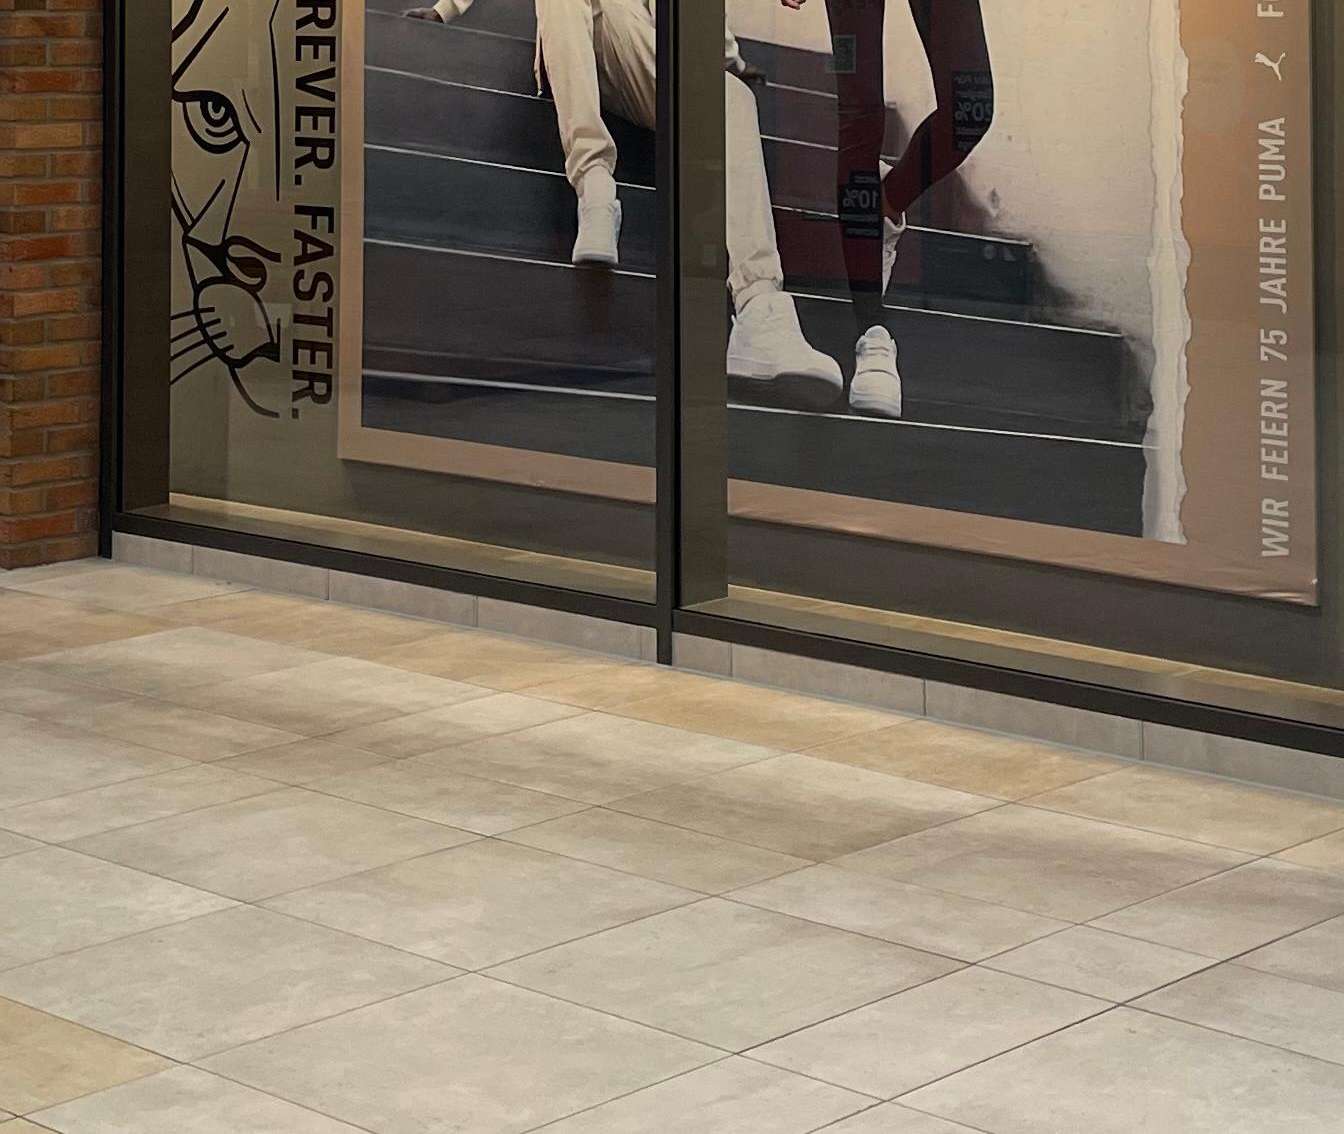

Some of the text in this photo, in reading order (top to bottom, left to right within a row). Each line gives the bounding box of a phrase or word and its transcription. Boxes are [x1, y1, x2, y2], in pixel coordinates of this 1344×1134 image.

[1258, 117, 1286, 201] PUMA
[1259, 218, 1288, 314] JAHRE
[291, 205, 335, 419] FASTER.
[1260, 328, 1288, 362] 75
[1260, 378, 1289, 481] FEIERN
[1262, 497, 1290, 557] WIR
